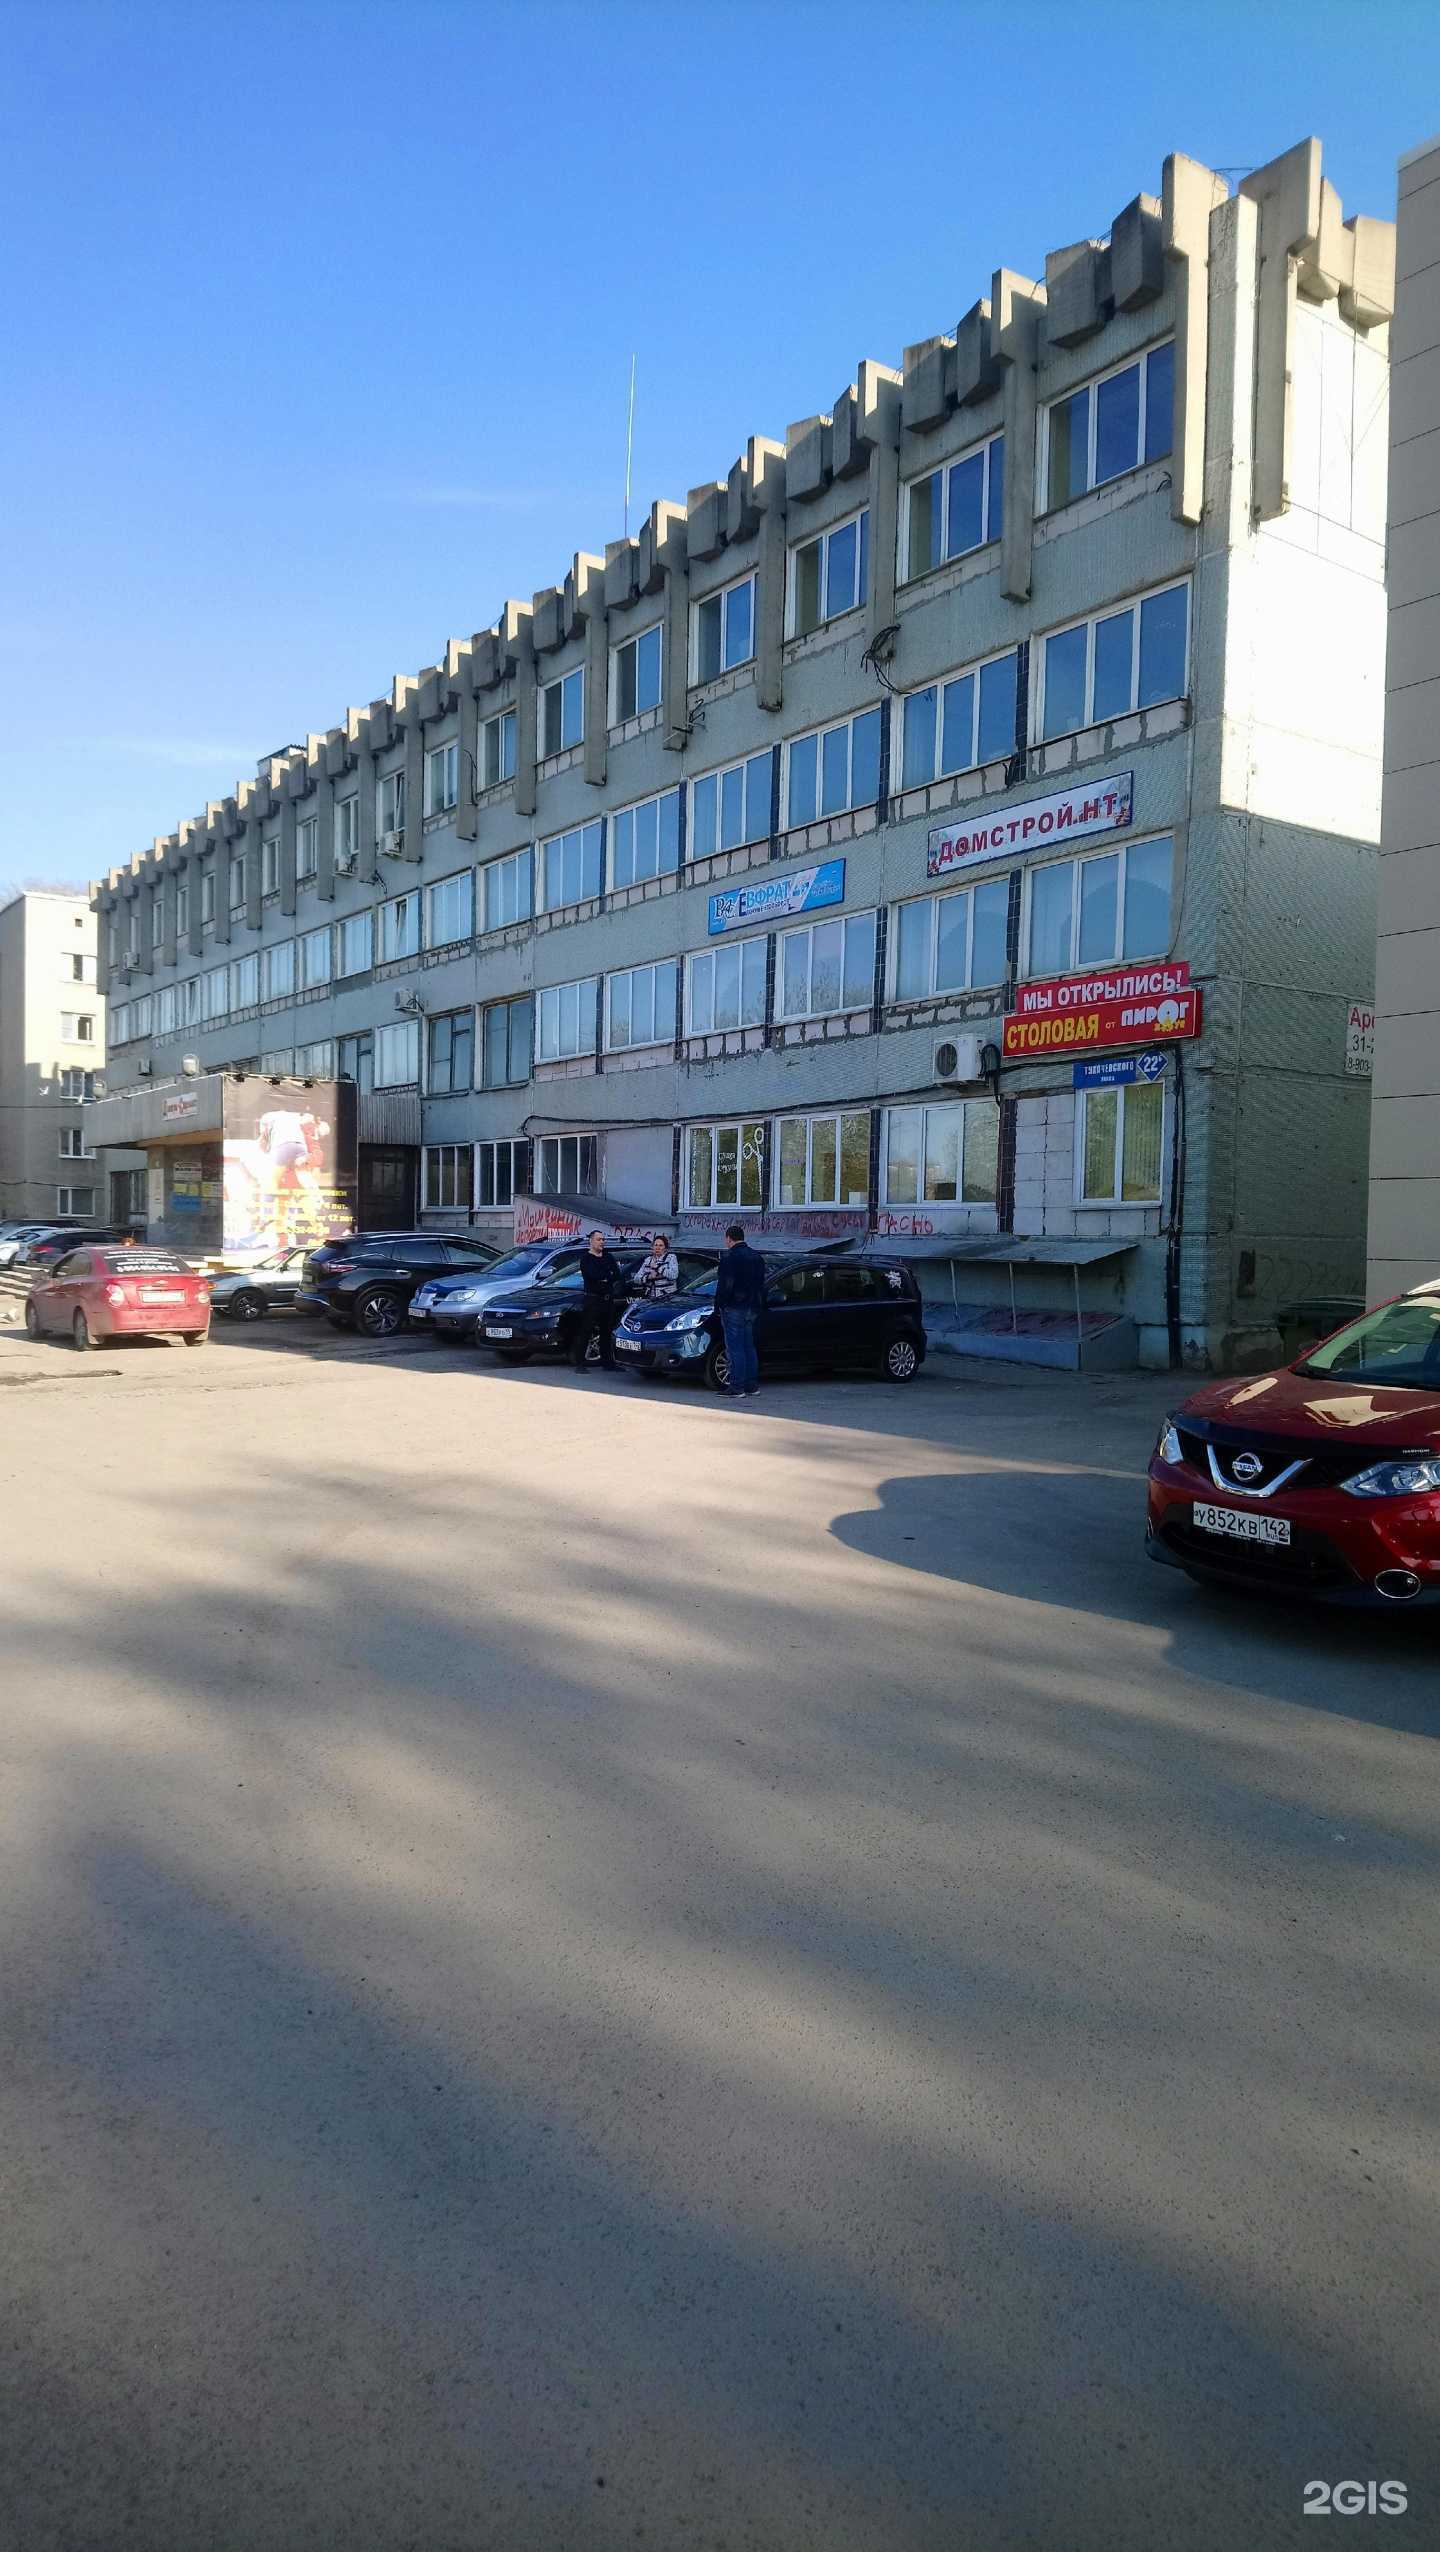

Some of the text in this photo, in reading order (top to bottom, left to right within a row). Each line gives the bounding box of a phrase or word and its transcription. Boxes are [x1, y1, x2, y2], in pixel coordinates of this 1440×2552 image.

[1023, 969, 1182, 1012] МЫ ОТКРЫЛИСЬ!
[1006, 1013, 1100, 1049] СТОЛОВАЯ
[1120, 999, 1190, 1027] ПИРОГ
[1261, 1518, 1287, 1536] 142
